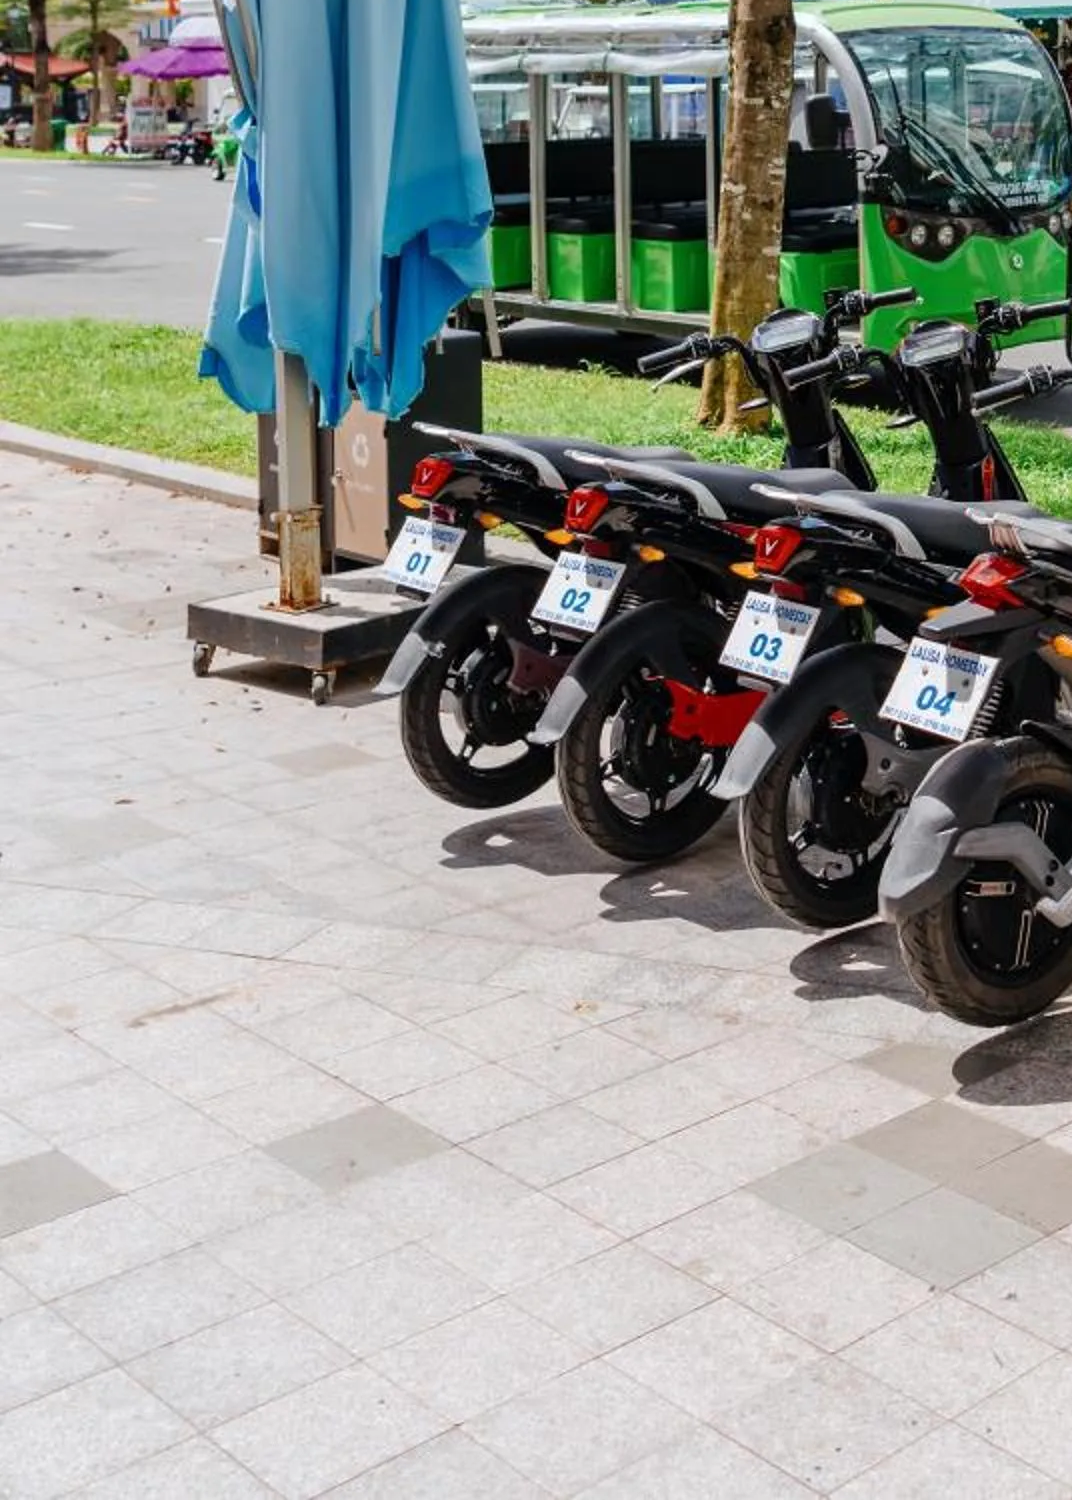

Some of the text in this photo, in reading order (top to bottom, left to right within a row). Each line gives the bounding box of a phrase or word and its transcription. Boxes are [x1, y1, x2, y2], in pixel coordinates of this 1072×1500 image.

[406, 552, 432, 574] 01
[561, 588, 591, 613] 02
[750, 633, 783, 661] 03
[917, 685, 957, 716] 04
